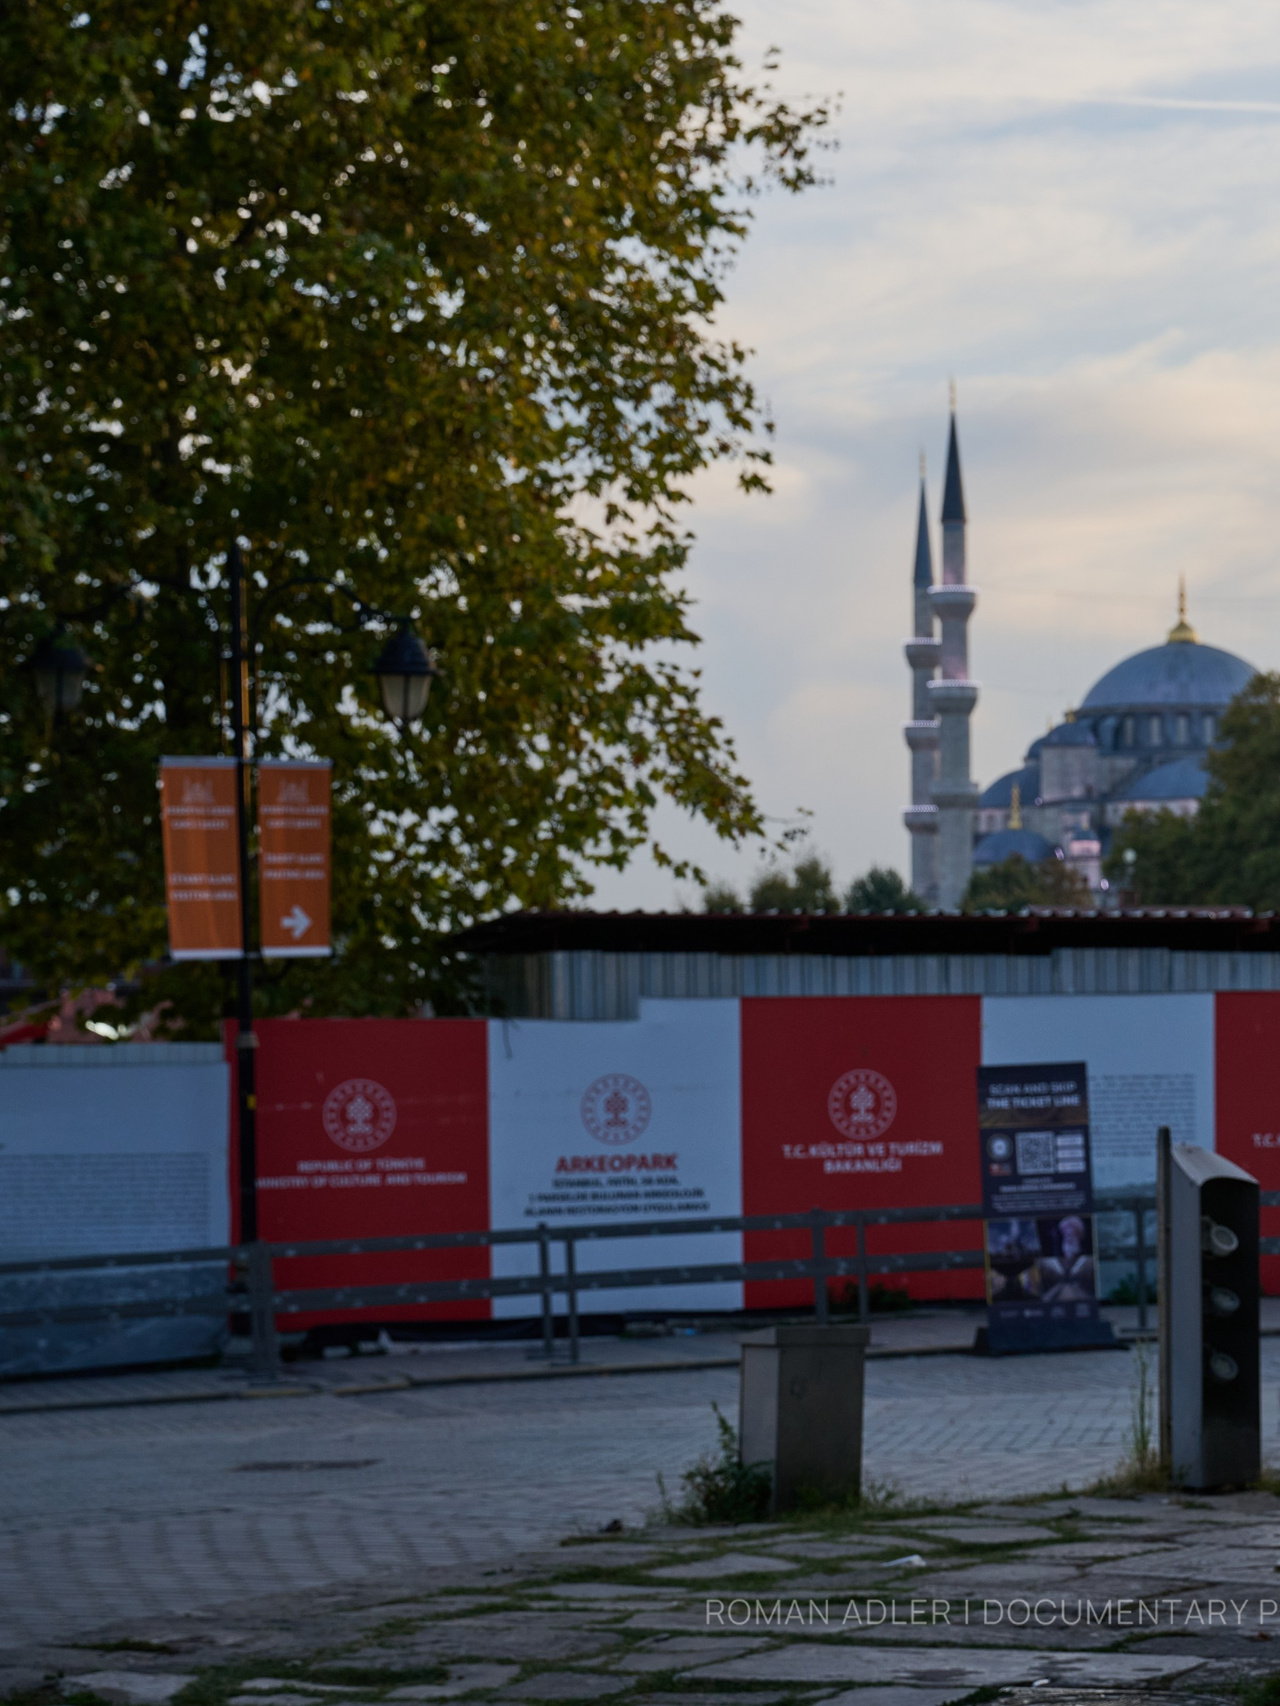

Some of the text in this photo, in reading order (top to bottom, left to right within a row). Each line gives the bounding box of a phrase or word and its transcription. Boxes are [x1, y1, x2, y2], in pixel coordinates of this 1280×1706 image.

[1023, 1082, 1048, 1095] AND
[1050, 1080, 1077, 1094] SKIP
[987, 1094, 1080, 1109] THE TICKET LINE
[808, 1141, 864, 1157] KÜLTÜR
[867, 1142, 885, 1156] VE
[889, 1139, 944, 1155] TURİZM
[297, 1160, 353, 1173] REPUBLIC
[356, 1159, 371, 1171] OF
[556, 1153, 678, 1175] ARKEOPARK
[824, 1157, 902, 1174] BAKANLIĞI
[312, 1175, 327, 1188] OF
[331, 1174, 381, 1187] CULTURE
[385, 1173, 410, 1186] AND
[414, 1172, 467, 1184] TOURISM
